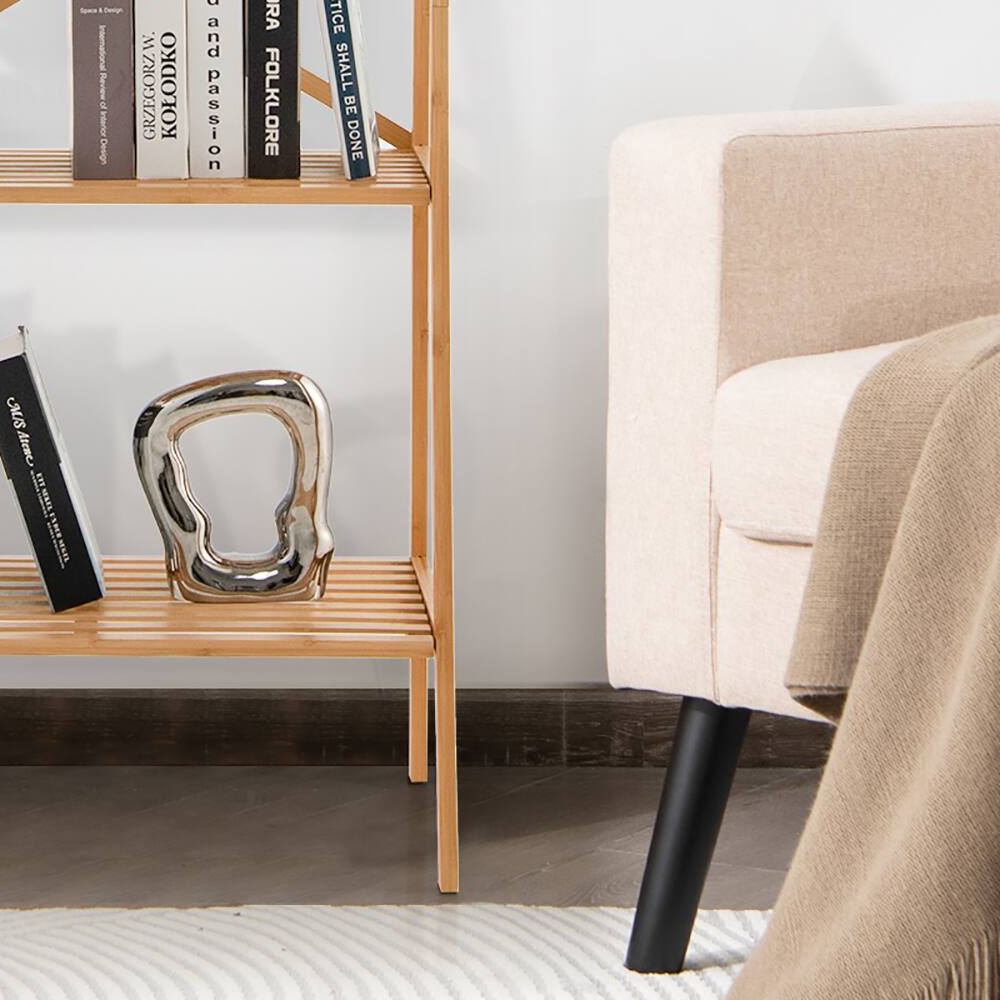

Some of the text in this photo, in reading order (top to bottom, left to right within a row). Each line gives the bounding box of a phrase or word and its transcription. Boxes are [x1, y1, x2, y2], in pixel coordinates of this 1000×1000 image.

[99, 25, 107, 71] International
[207, 17, 220, 58] and
[99, 73, 108, 101] Review
[143, 32, 156, 140] GRZEGORZ W.
[336, 42, 353, 91] SHALL
[207, 69, 221, 170] passion
[265, 47, 281, 157] FOLKLORE
[344, 96, 357, 116] BE
[100, 111, 108, 138] Interior
[347, 121, 364, 161] DONE
[99, 139, 108, 165] Design
